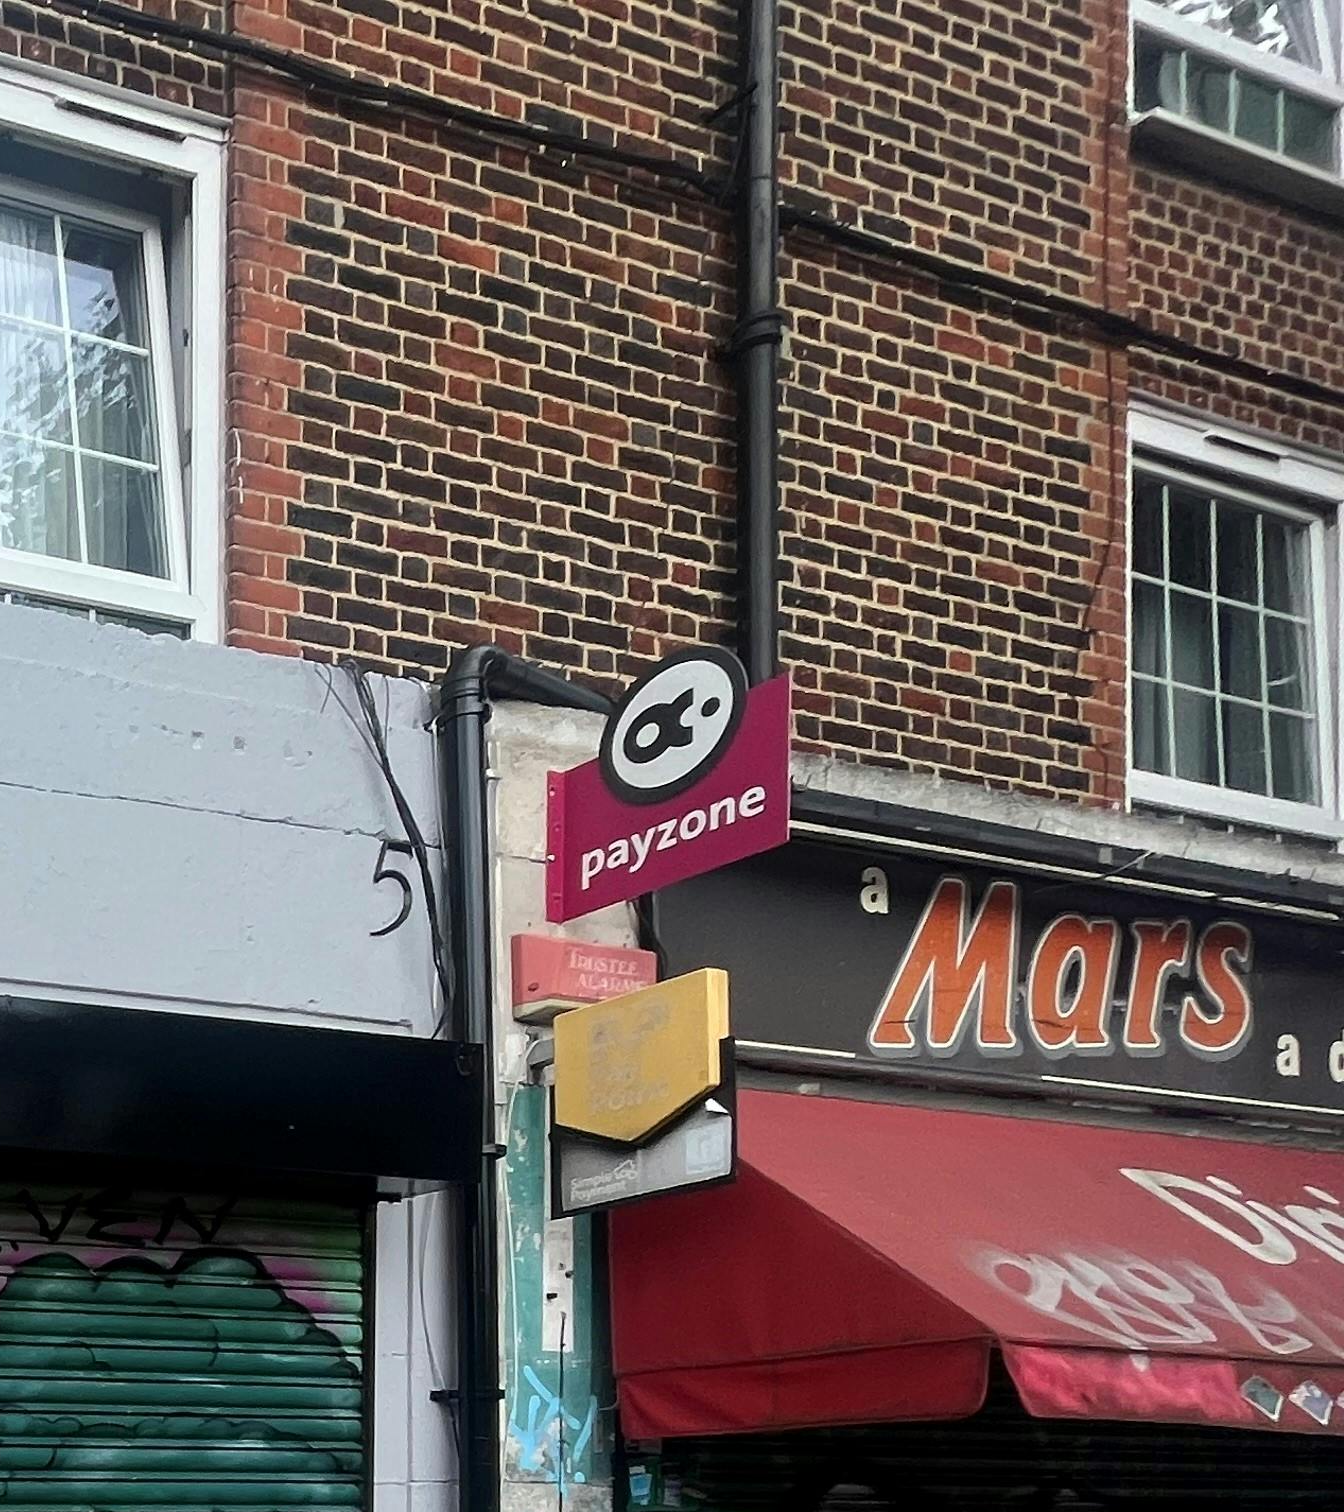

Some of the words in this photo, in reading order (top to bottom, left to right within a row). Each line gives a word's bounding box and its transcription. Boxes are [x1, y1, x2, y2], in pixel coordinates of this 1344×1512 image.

[581, 784, 766, 890] payzone
[369, 839, 414, 937] 5
[860, 866, 889, 914] a
[868, 876, 1251, 1058] Mars
[1275, 1033, 1300, 1077] a
